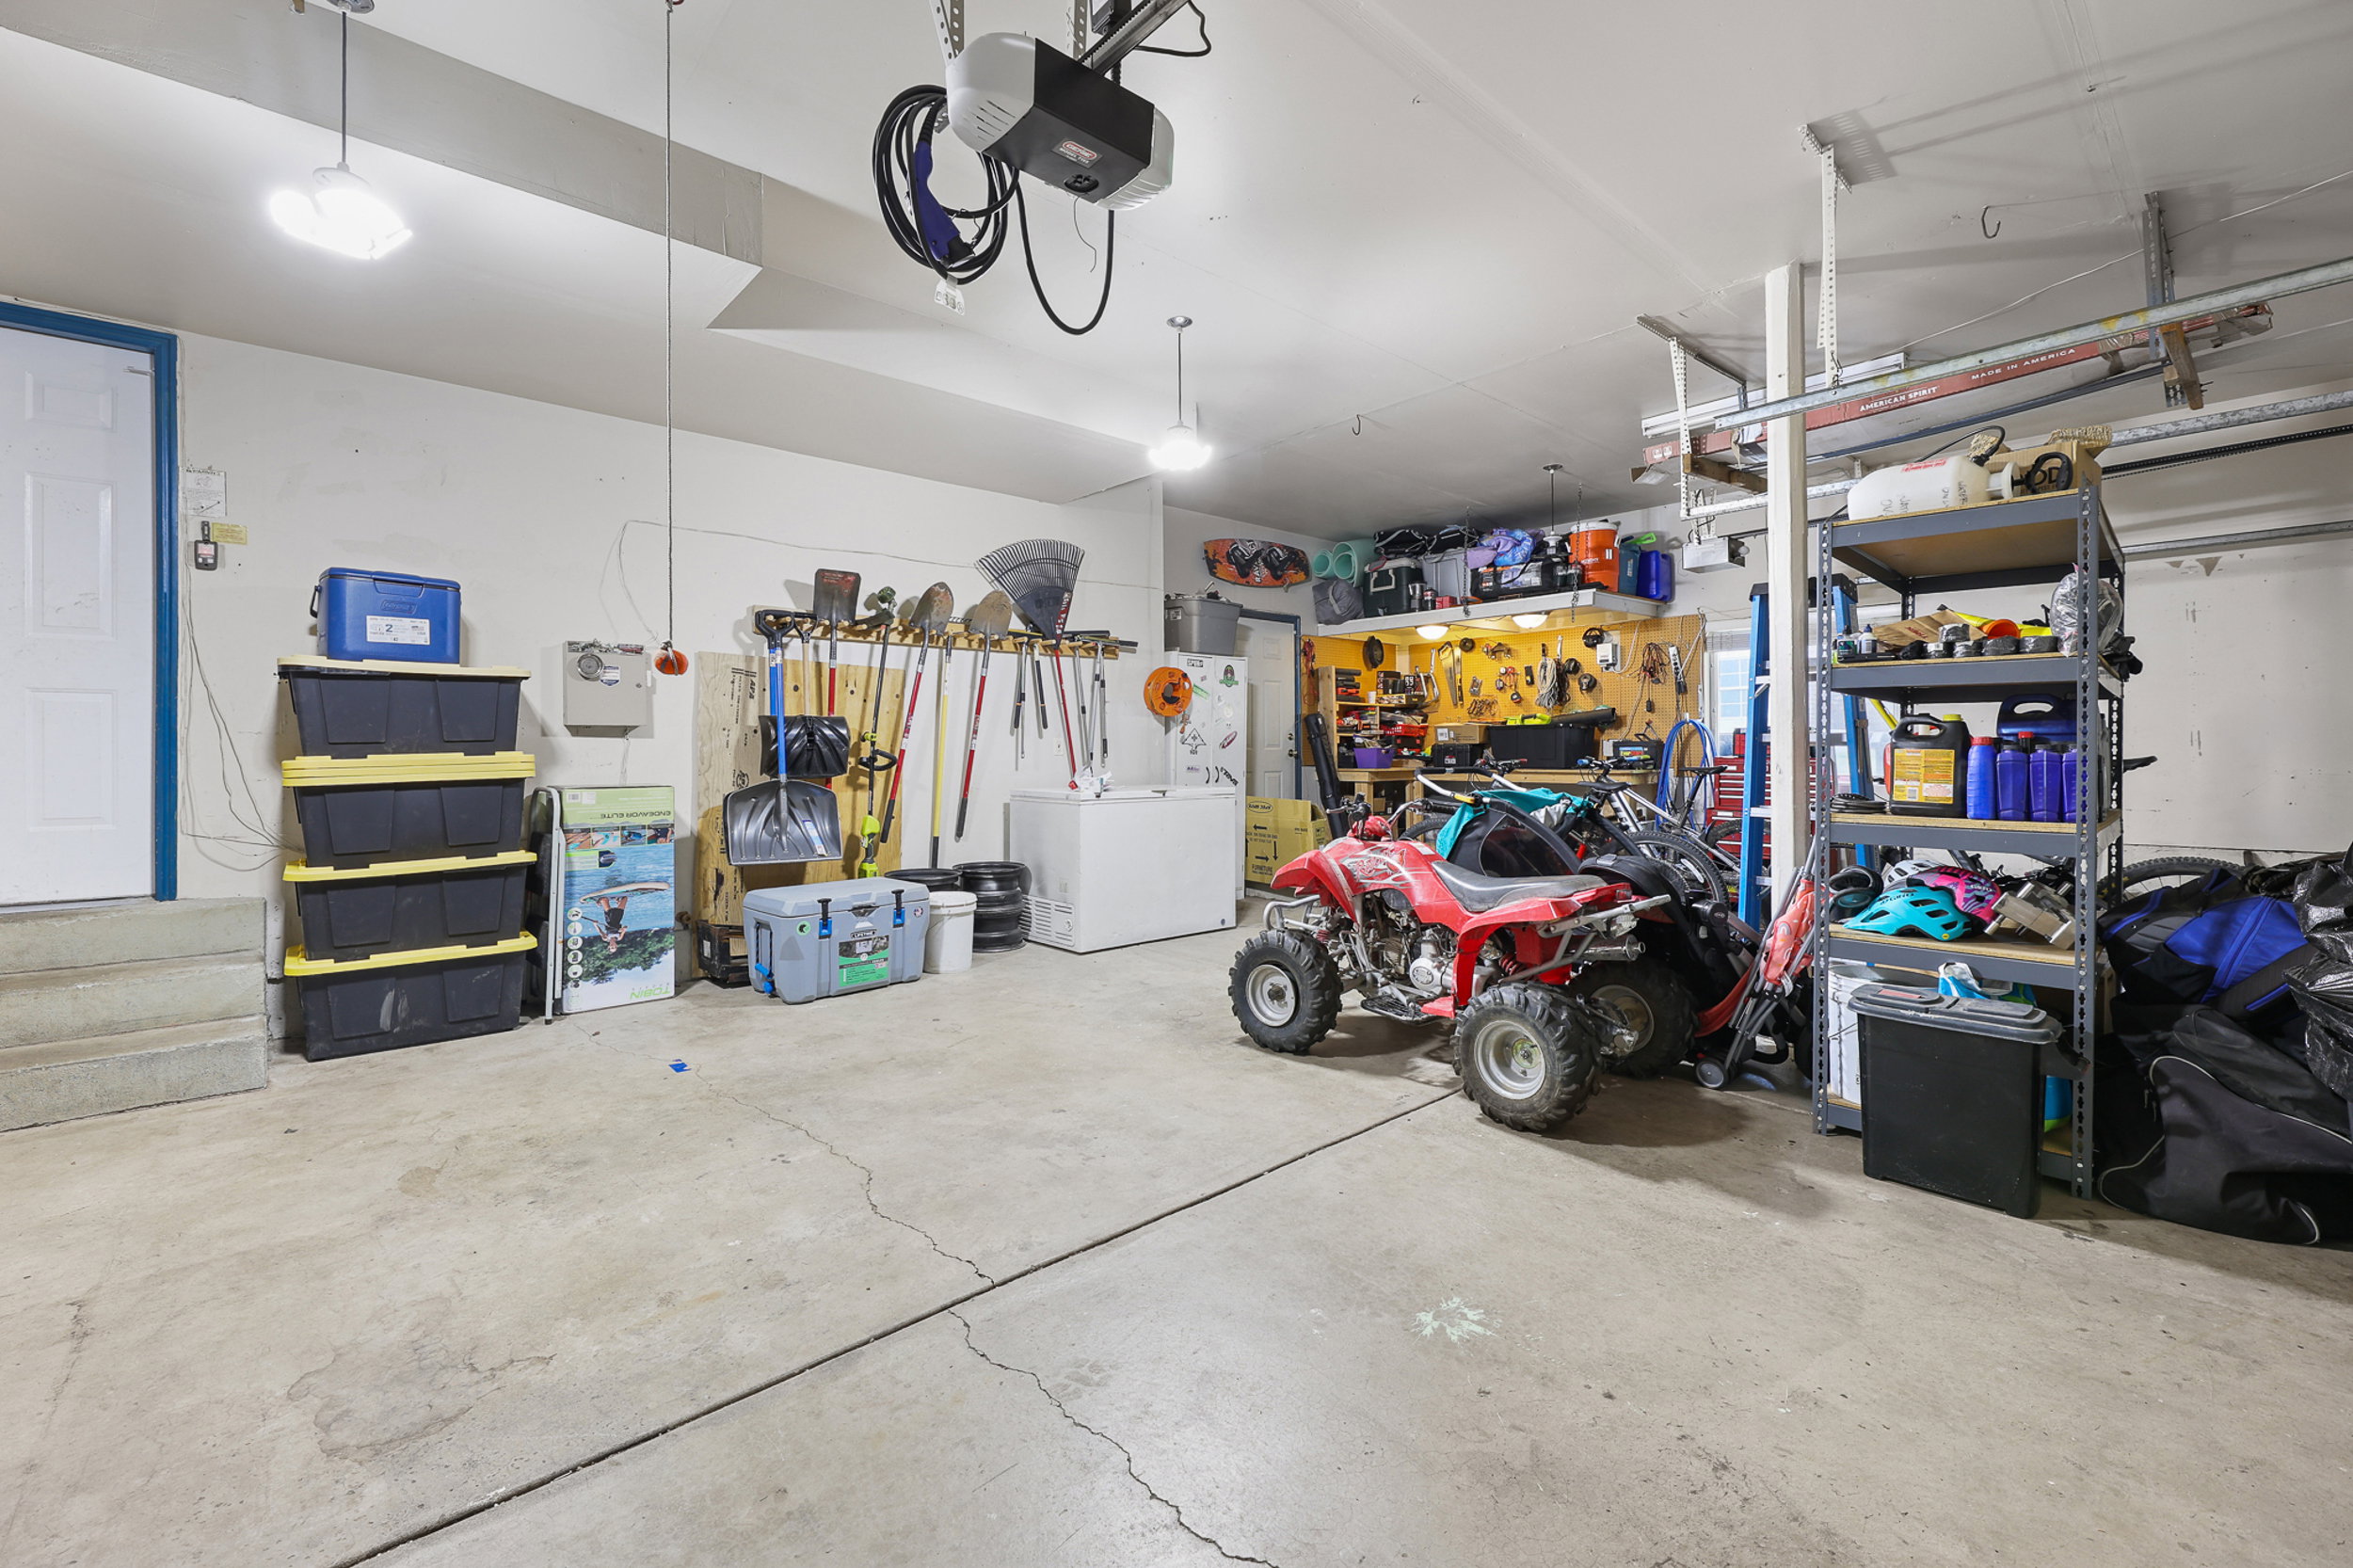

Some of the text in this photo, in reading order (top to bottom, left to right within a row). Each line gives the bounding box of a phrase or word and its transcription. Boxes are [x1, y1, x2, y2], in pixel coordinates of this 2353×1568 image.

[1971, 368, 2002, 380] MADE
[2023, 348, 2076, 366] AMERICA
[1859, 386, 1938, 412] AMERICAN SPIRIT
[385, 623, 393, 632] 2
[630, 986, 671, 1000] TOBIN
